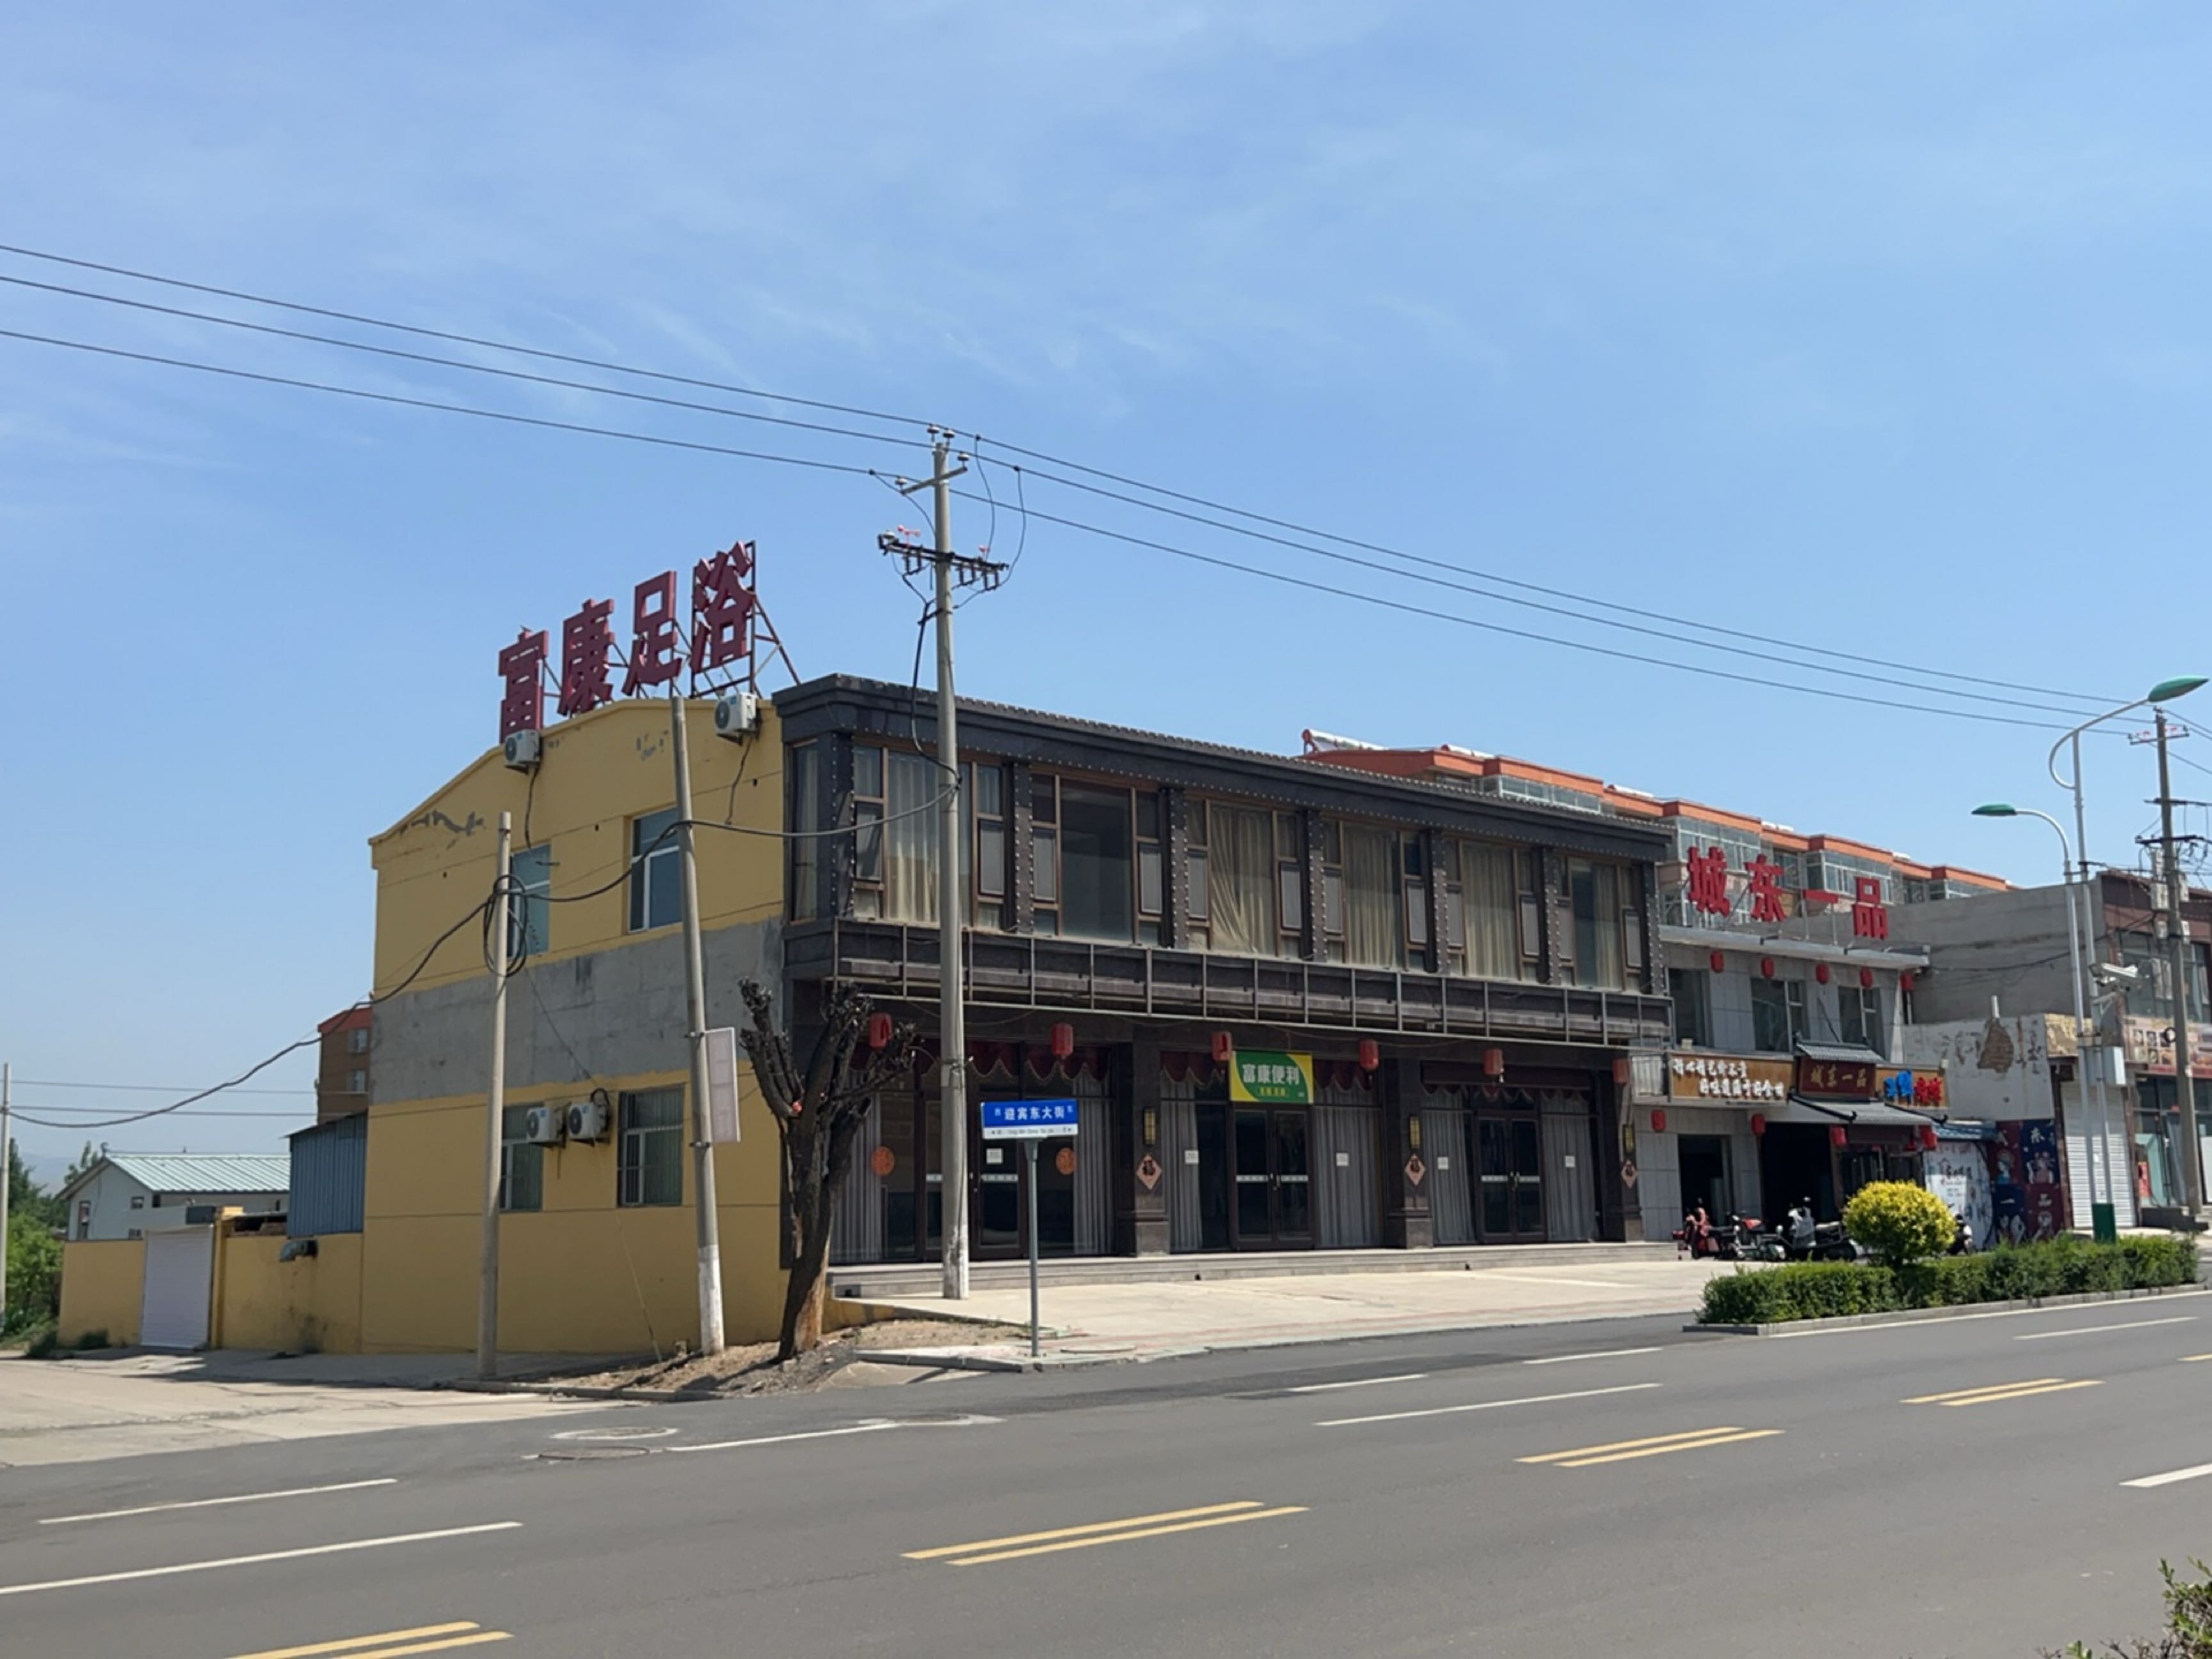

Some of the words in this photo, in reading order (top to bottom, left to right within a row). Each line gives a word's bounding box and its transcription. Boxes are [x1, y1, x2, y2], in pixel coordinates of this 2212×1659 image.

[499, 541, 755, 744] 富康足浴
[1687, 846, 1889, 940] 城东一品
[1242, 1064, 1300, 1085] 富康便利
[1004, 1105, 1065, 1120] 迎宾东大街
